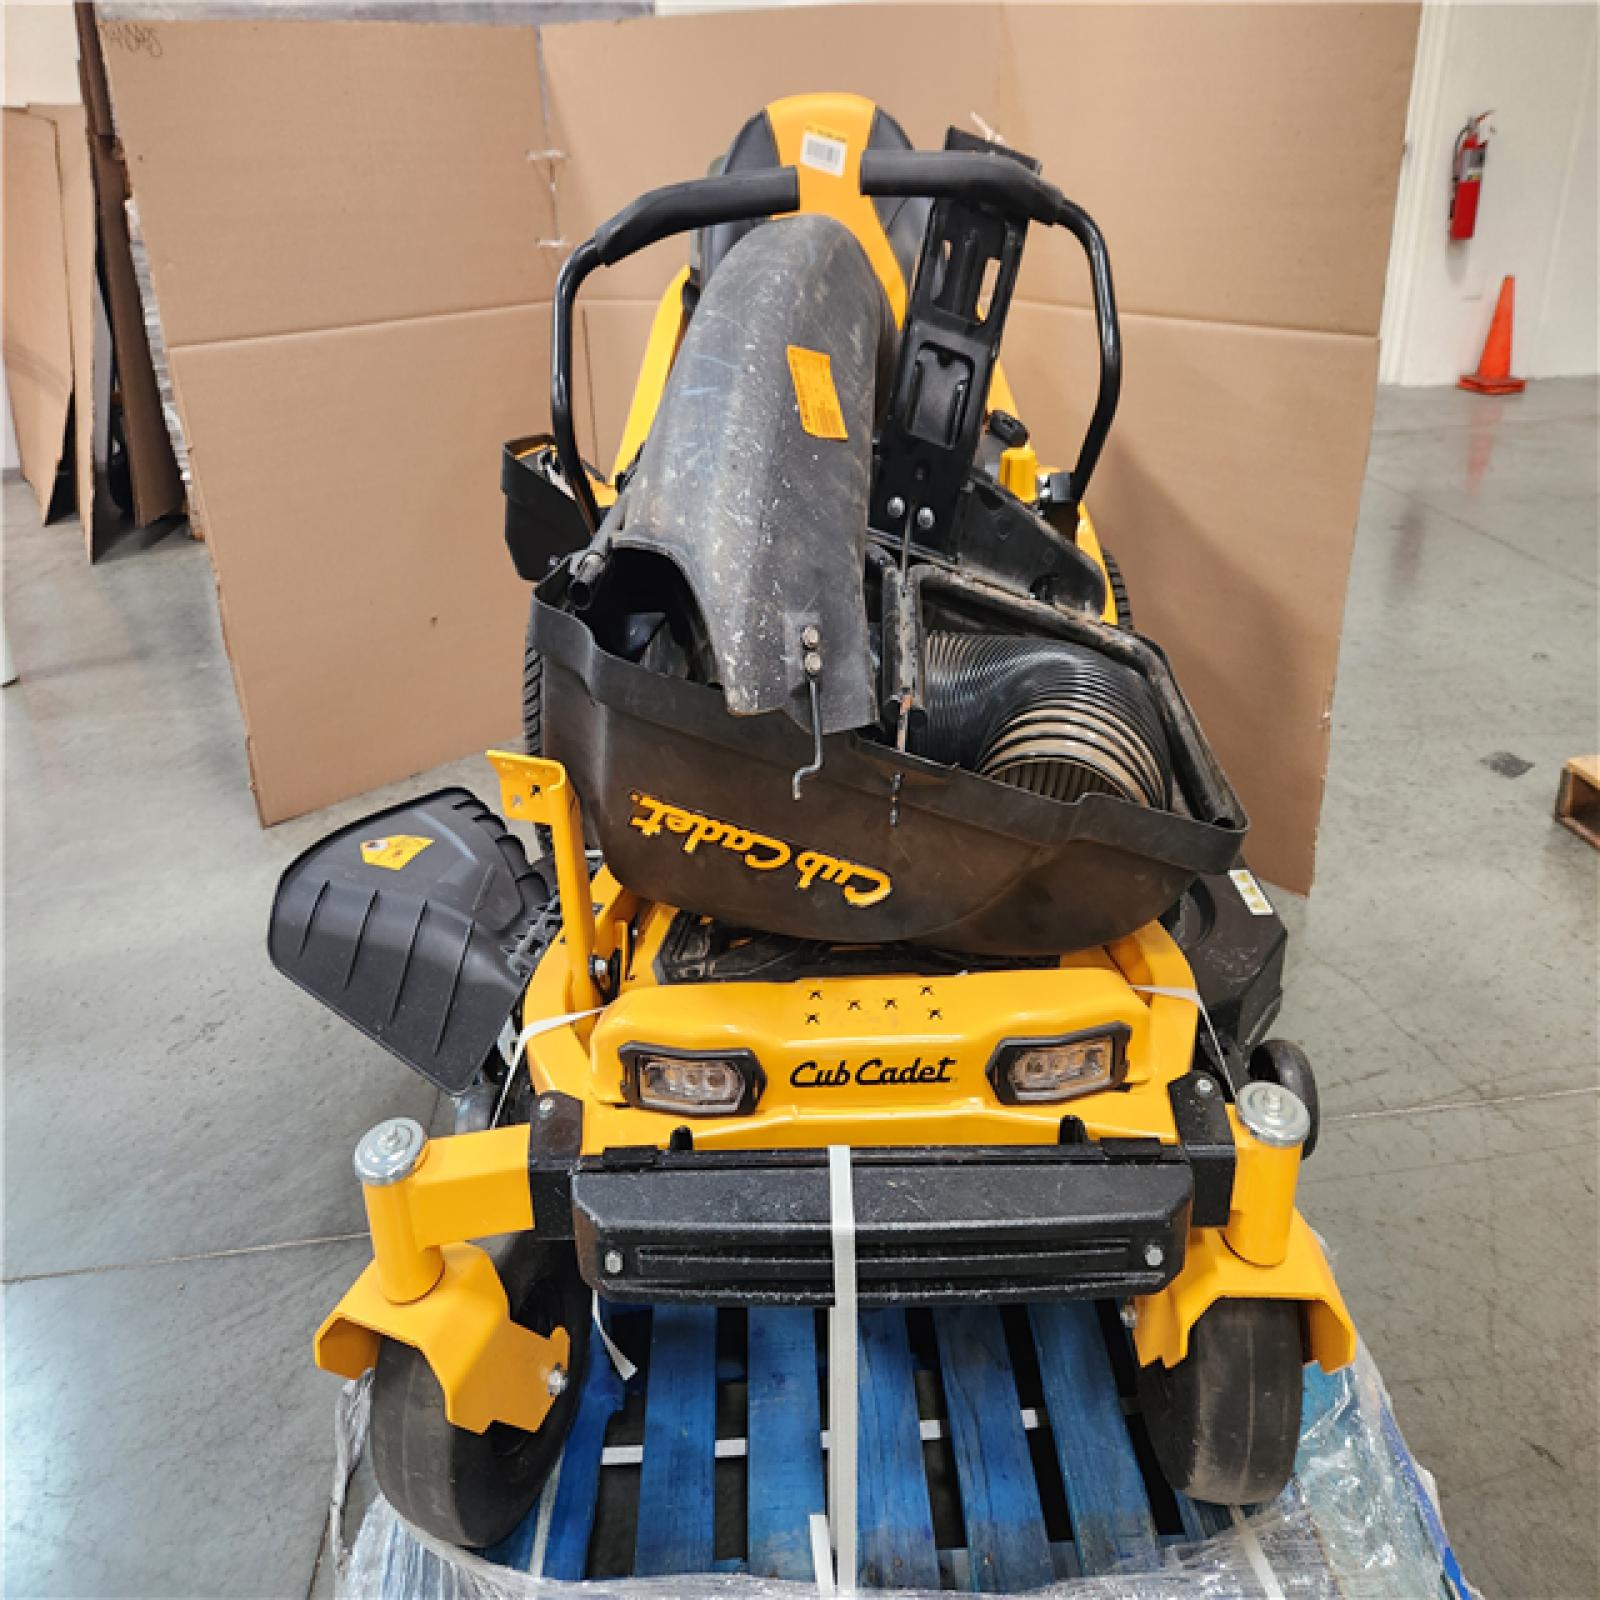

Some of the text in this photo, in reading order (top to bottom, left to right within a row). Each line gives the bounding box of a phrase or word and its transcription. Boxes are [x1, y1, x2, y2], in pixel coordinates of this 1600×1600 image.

[630, 793, 891, 907] Cub Cadet
[790, 1057, 957, 1088] Cub Cadet
